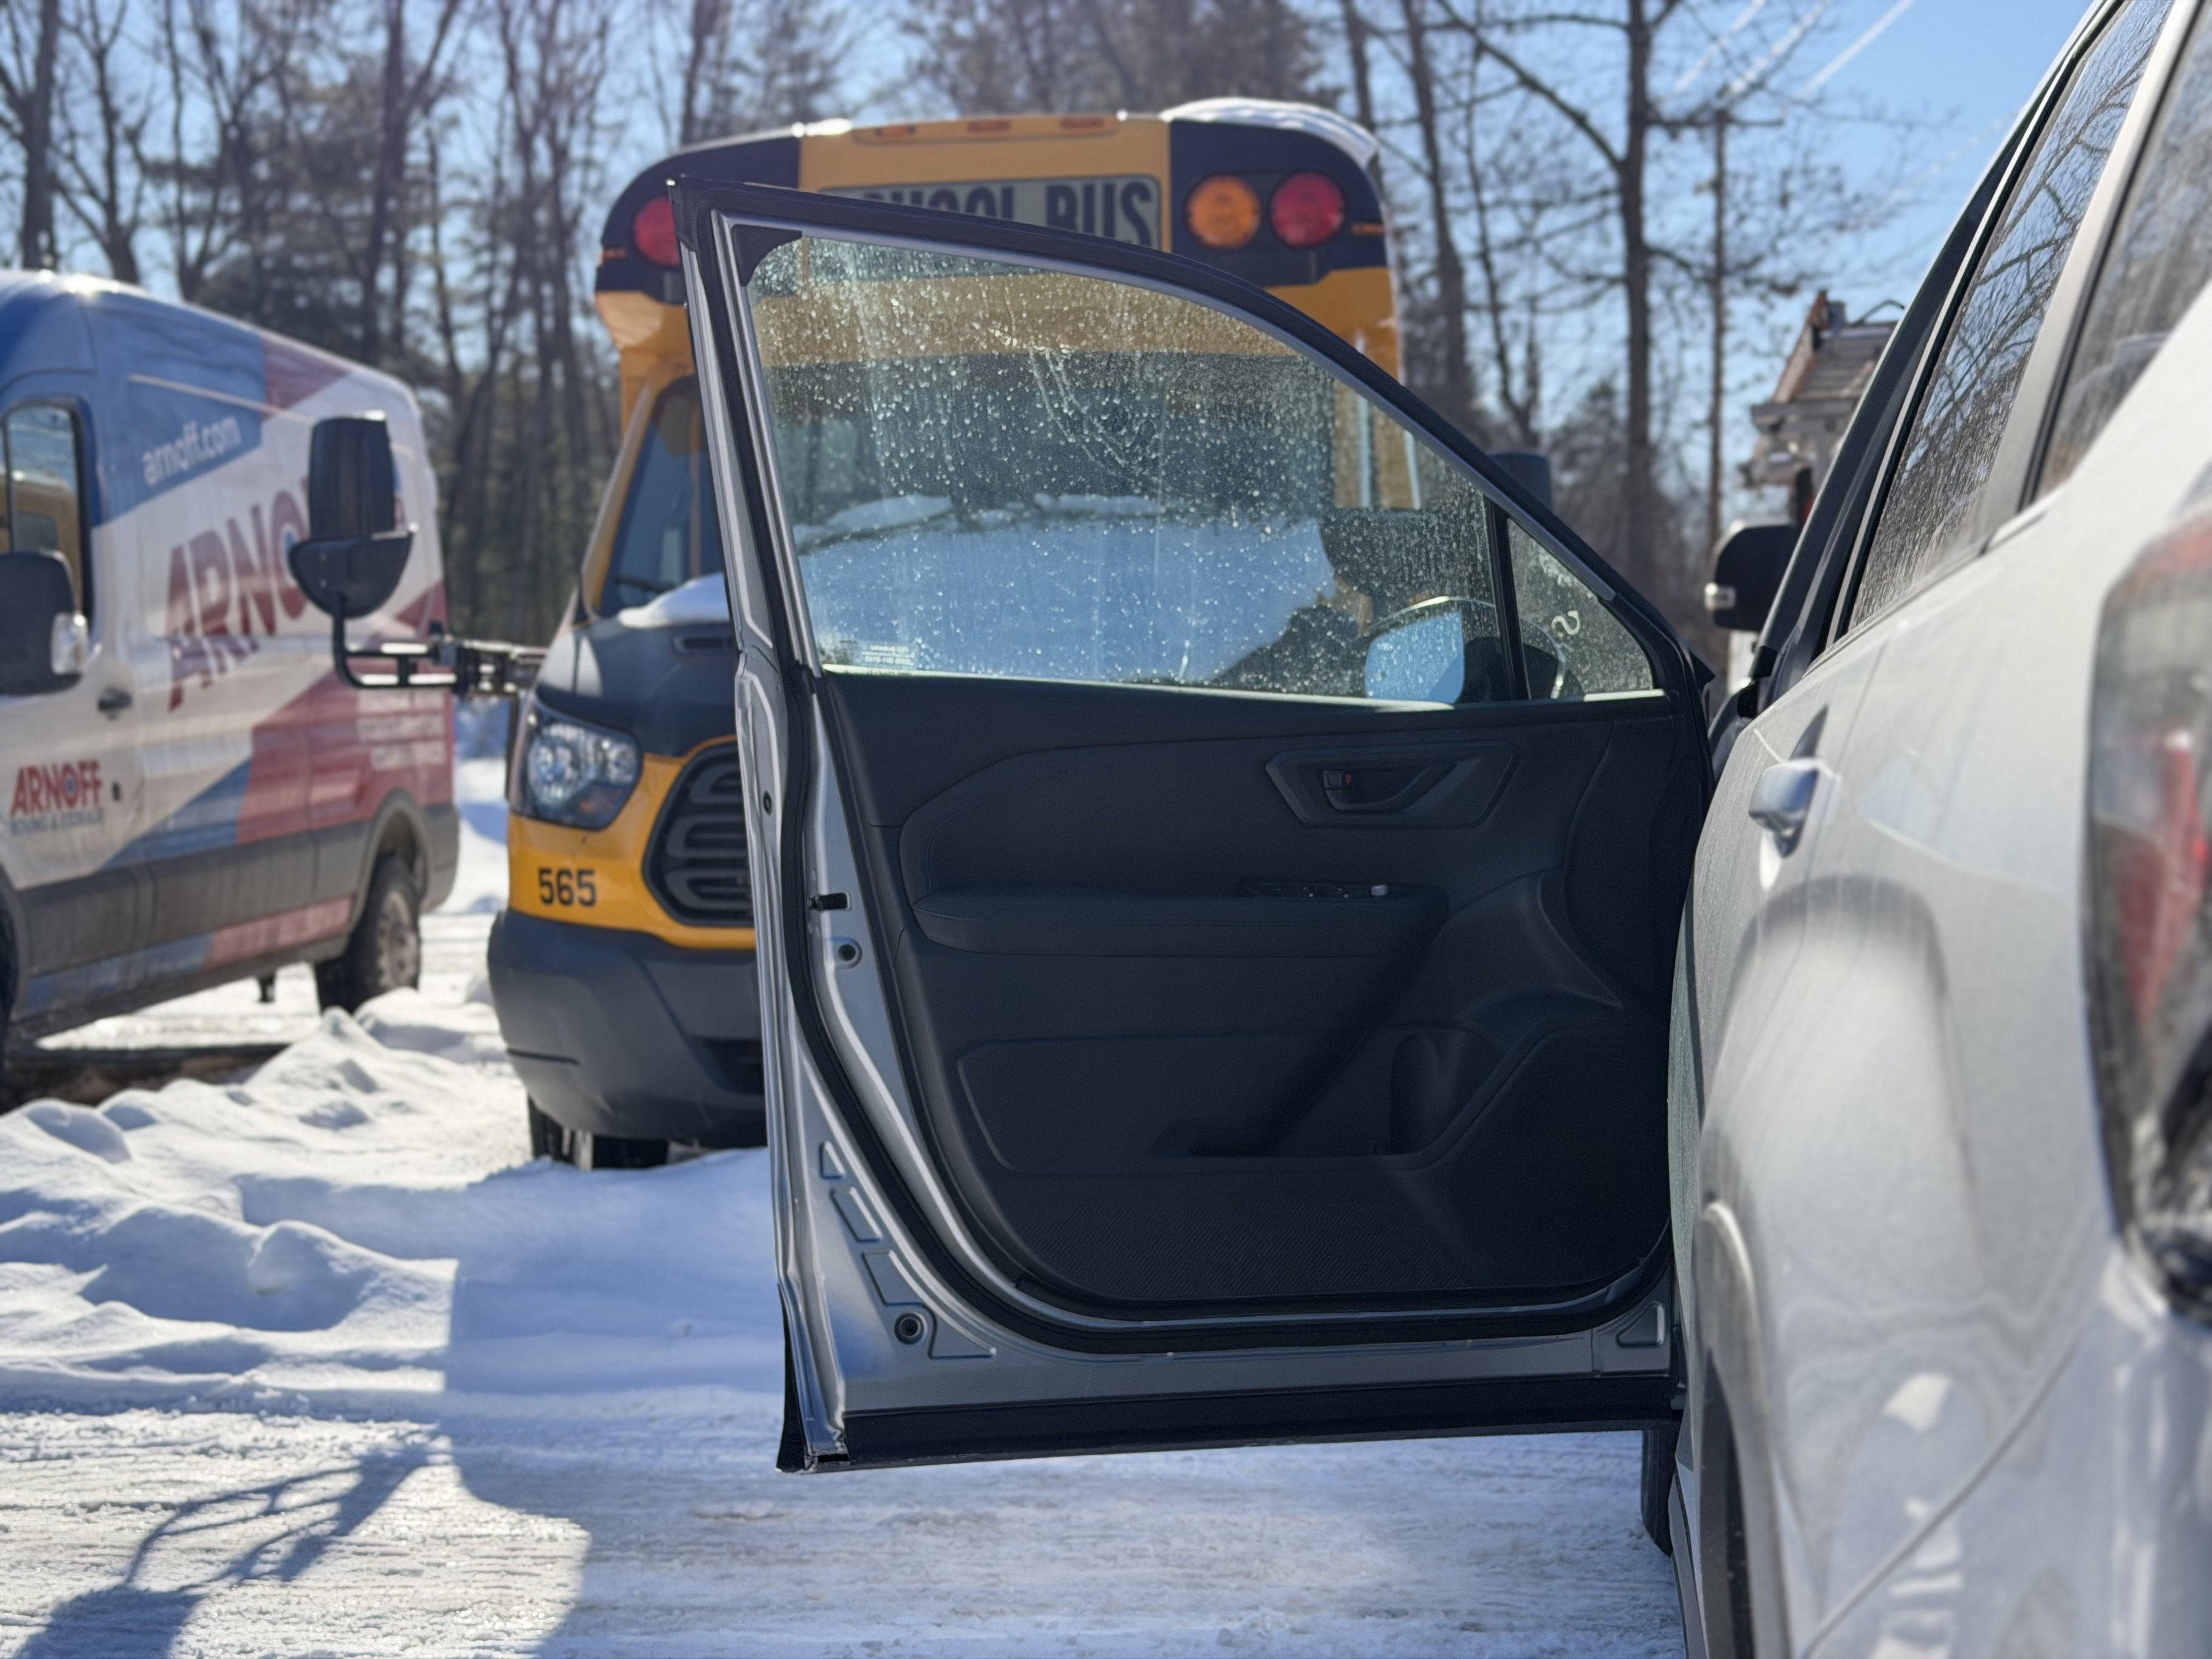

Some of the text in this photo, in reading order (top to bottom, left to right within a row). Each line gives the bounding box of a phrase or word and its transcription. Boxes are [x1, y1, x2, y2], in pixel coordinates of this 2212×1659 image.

[1046, 182, 1152, 247] BUS
[142, 416, 242, 487] arnoff.com
[10, 759, 103, 817] ARNOFF
[538, 867, 597, 907] 565
